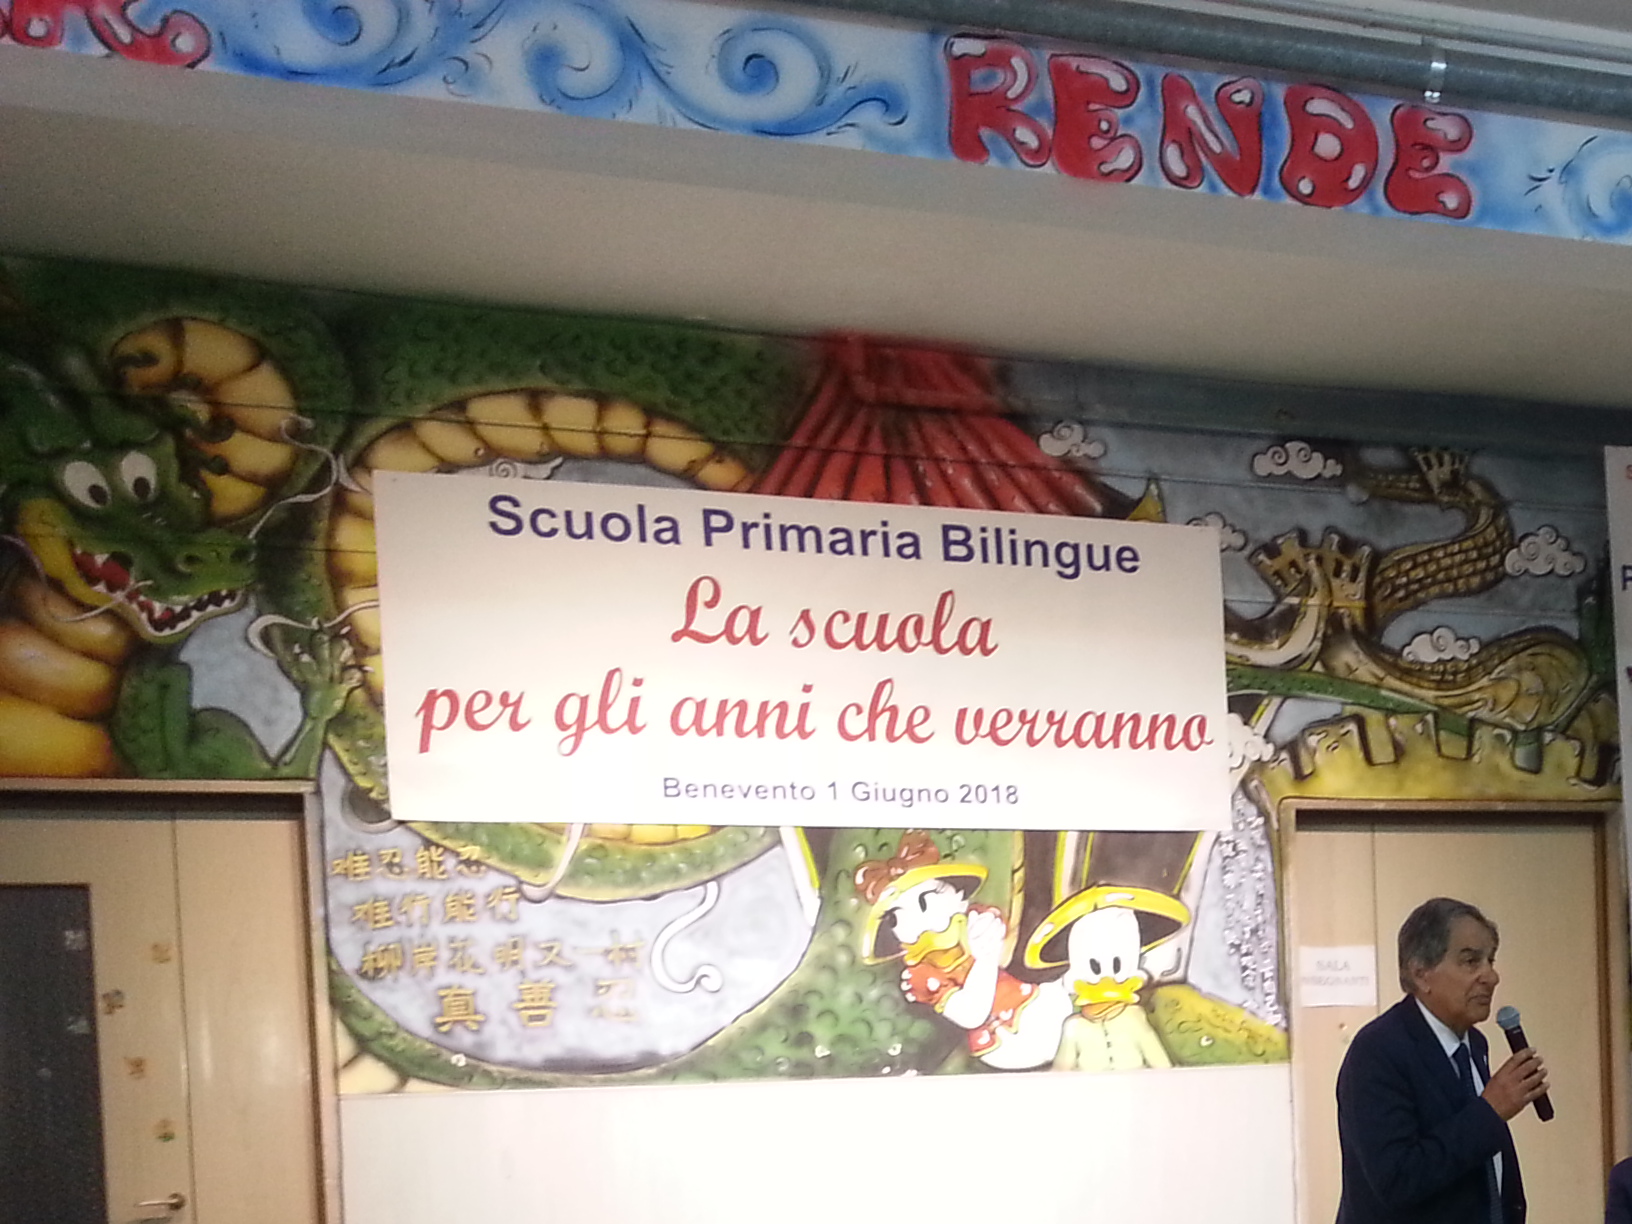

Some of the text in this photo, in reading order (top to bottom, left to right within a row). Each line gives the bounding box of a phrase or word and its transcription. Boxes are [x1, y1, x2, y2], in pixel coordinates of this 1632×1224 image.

[943, 32, 1474, 220] RENDE
[487, 493, 1142, 580] Scuola Primaria Bilingue
[670, 575, 999, 659] La scuola
[414, 667, 1214, 757] per gli anni che verranno
[662, 777, 1019, 807] Benevento 1 Giugno 2018
